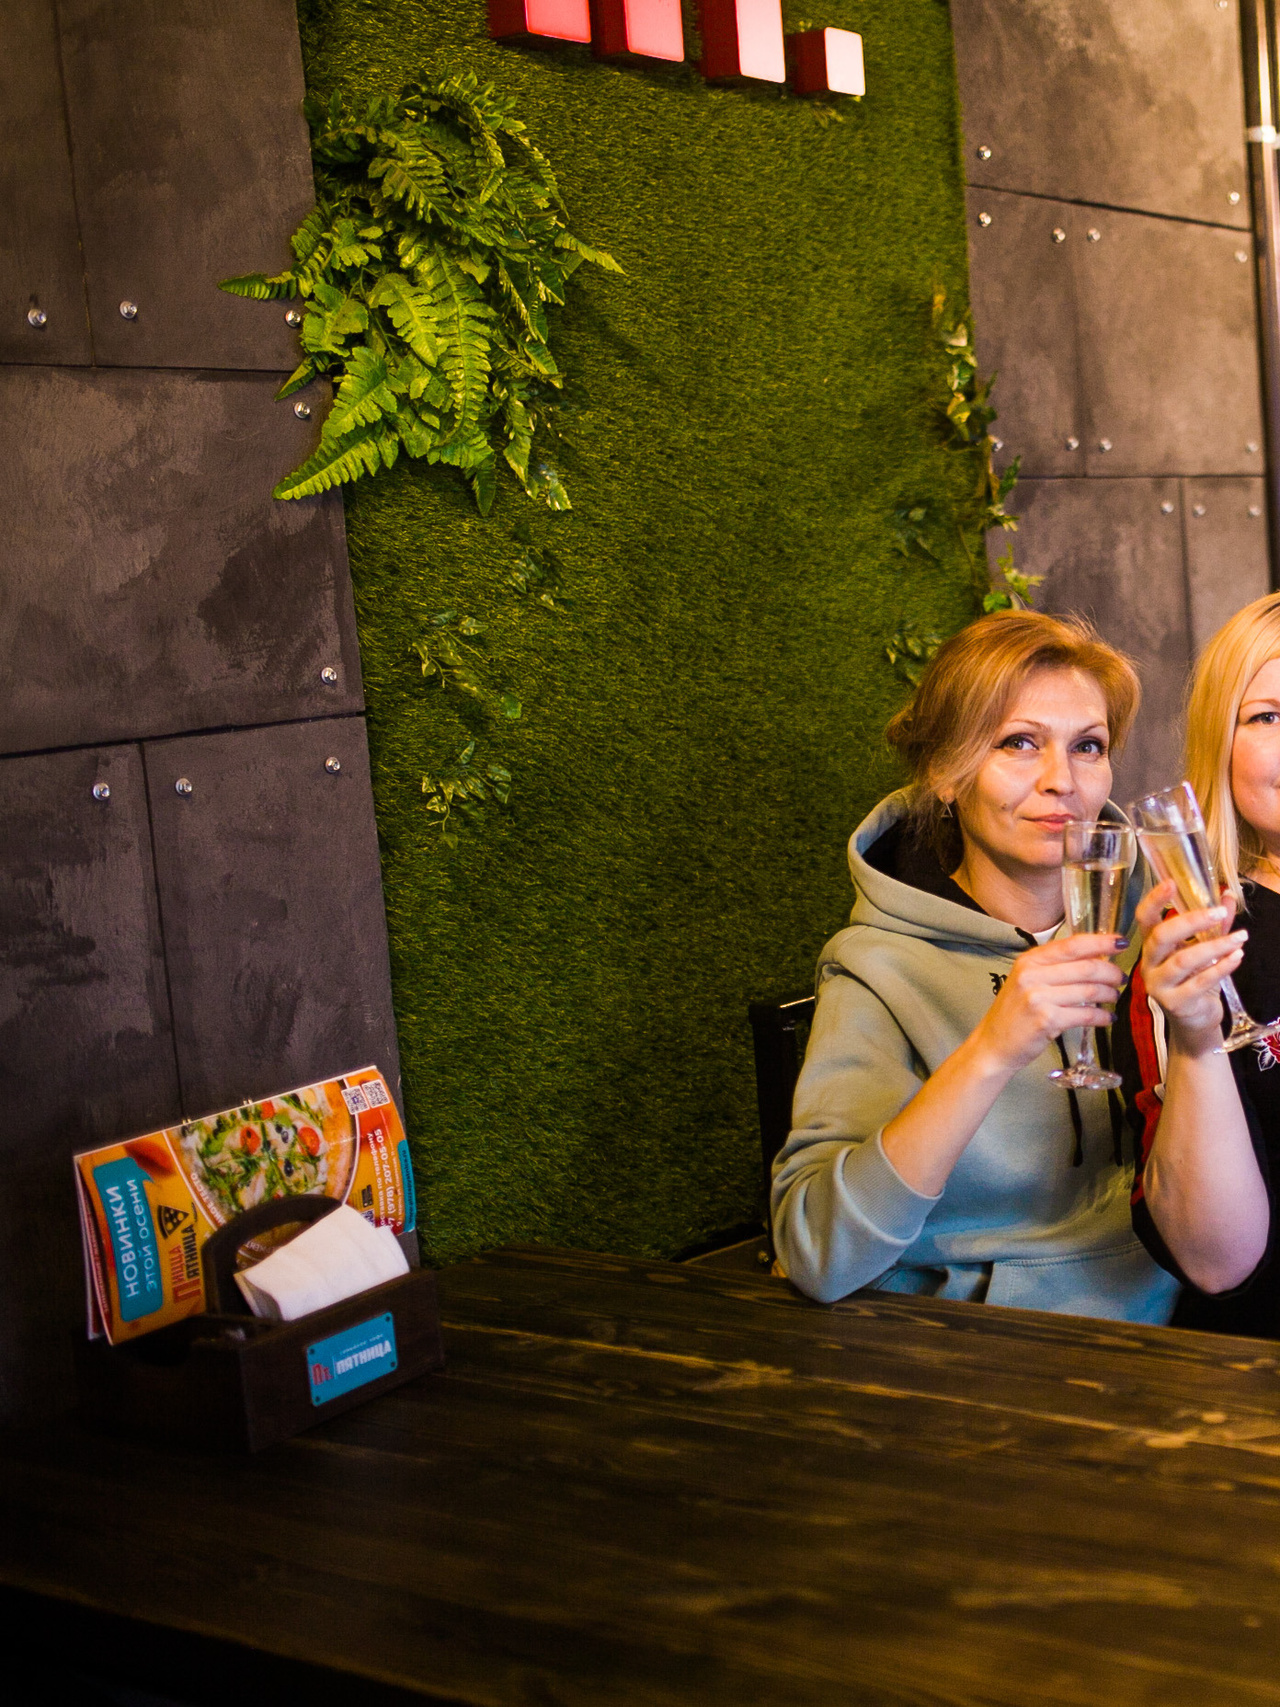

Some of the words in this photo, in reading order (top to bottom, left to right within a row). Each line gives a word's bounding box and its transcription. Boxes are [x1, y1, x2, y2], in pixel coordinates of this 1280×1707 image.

[367, 1132, 380, 1176] телефону
[374, 1128, 393, 1184] 207-05-05
[376, 1177, 383, 1190] по
[386, 1186, 396, 1214] (978)
[378, 1191, 386, 1226] оставка
[105, 1185, 139, 1298] НОВИНКИ
[335, 1339, 392, 1375] ПЯТНИЦА
